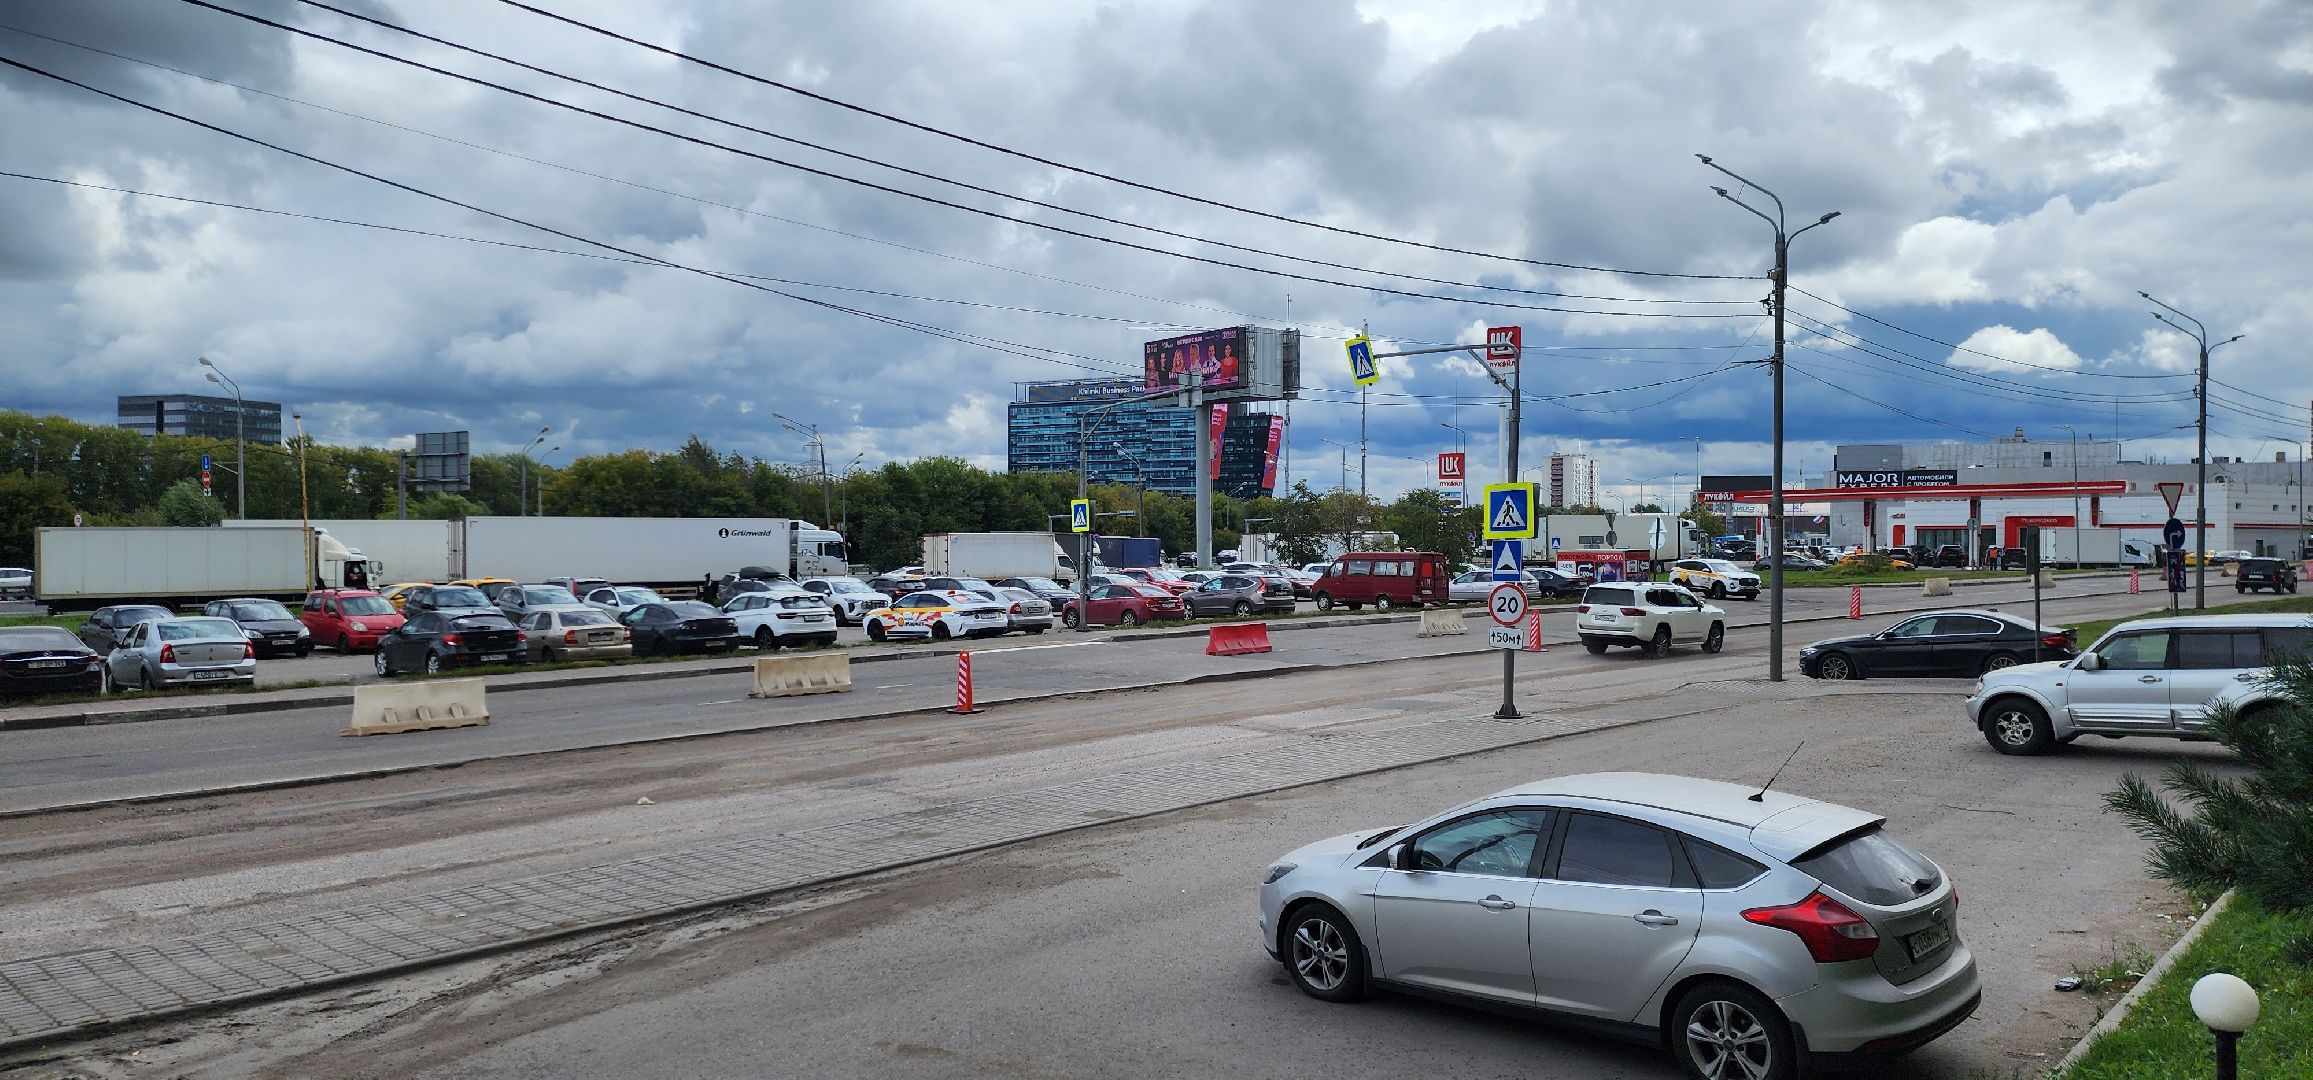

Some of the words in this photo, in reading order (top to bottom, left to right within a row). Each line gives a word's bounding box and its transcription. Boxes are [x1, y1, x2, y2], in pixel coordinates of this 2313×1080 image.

[1102, 386, 1130, 395] Business
[1839, 473, 1899, 483] MAJOR
[1703, 492, 1734, 501] ЛУКОЙЛ
[731, 529, 772, 537] Grünwald
[1496, 596, 1518, 614] 20
